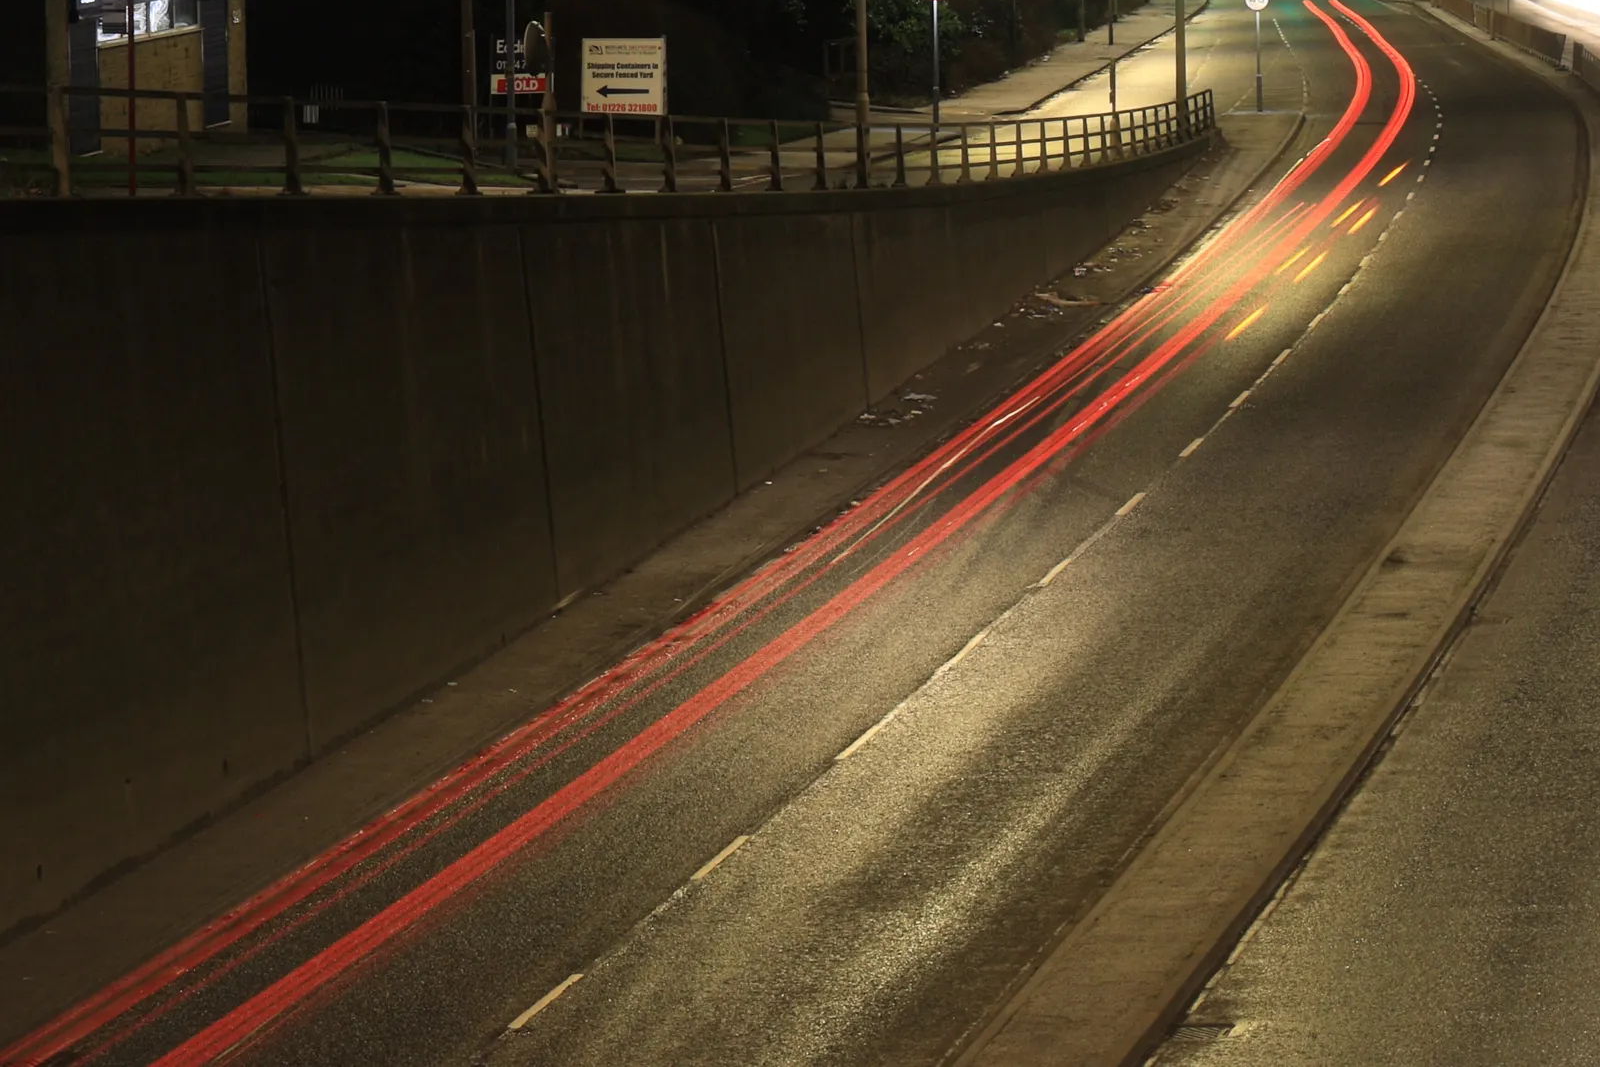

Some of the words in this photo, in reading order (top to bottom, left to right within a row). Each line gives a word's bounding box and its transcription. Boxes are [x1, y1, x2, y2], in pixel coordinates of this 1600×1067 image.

[587, 62, 615, 71] Shipping
[616, 62, 651, 70] Containers
[586, 102, 601, 111] Tel:
[602, 103, 626, 111] 01226
[628, 103, 657, 112] 321800
